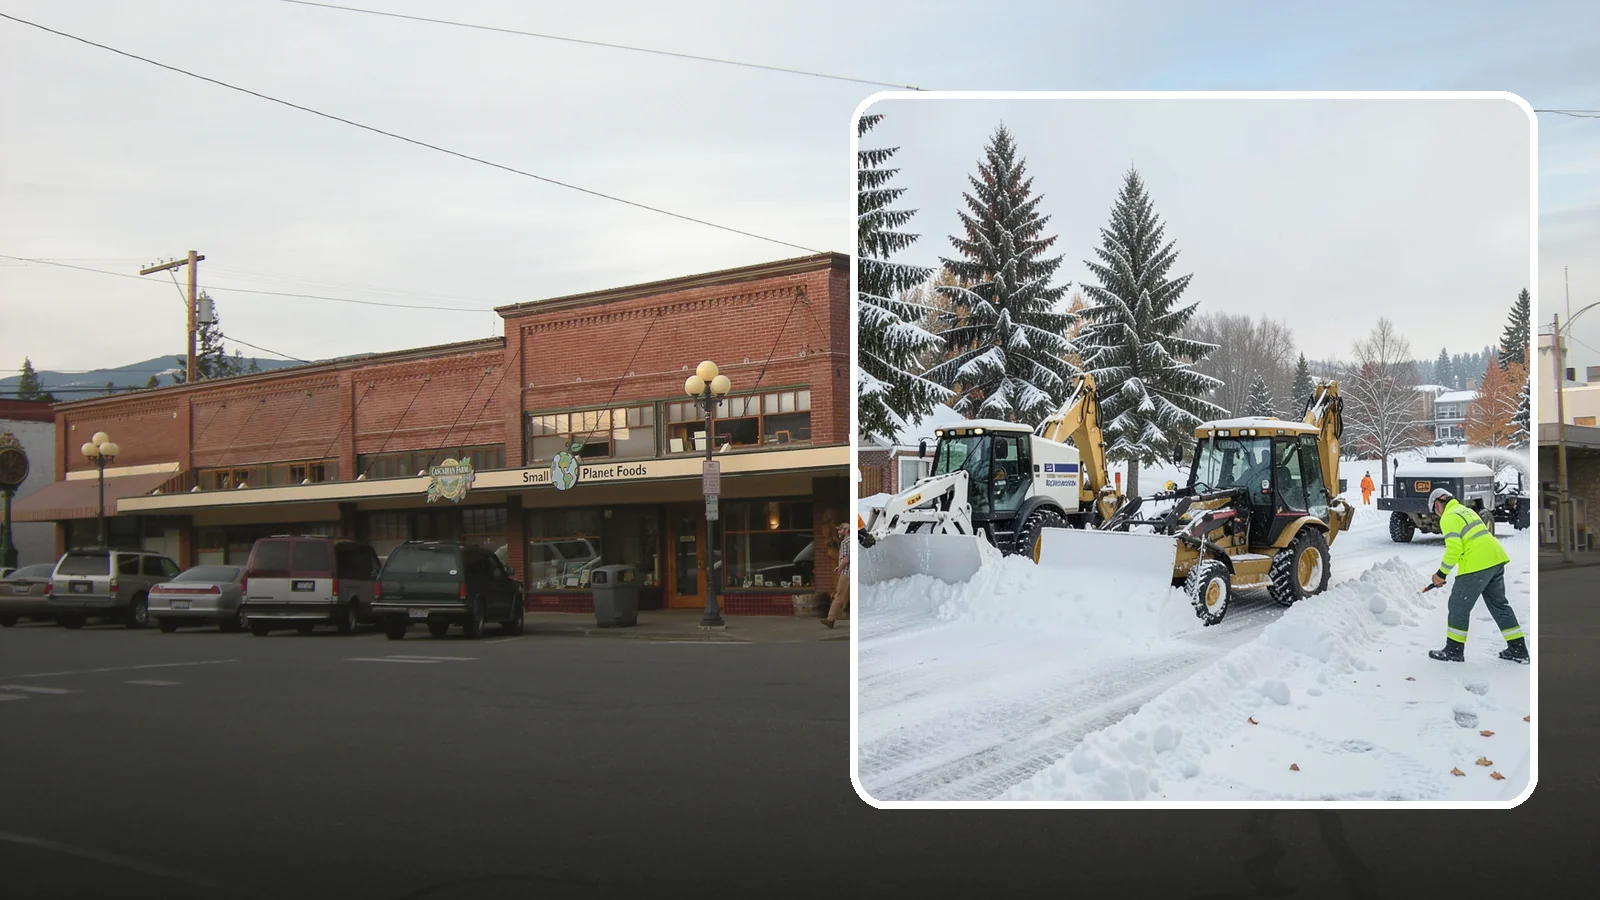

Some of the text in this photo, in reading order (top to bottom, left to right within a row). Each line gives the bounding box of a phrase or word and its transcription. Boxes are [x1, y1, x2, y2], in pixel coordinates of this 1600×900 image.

[431, 466, 456, 476] CASCADIAN
[523, 464, 647, 483] Small Planet Foods
